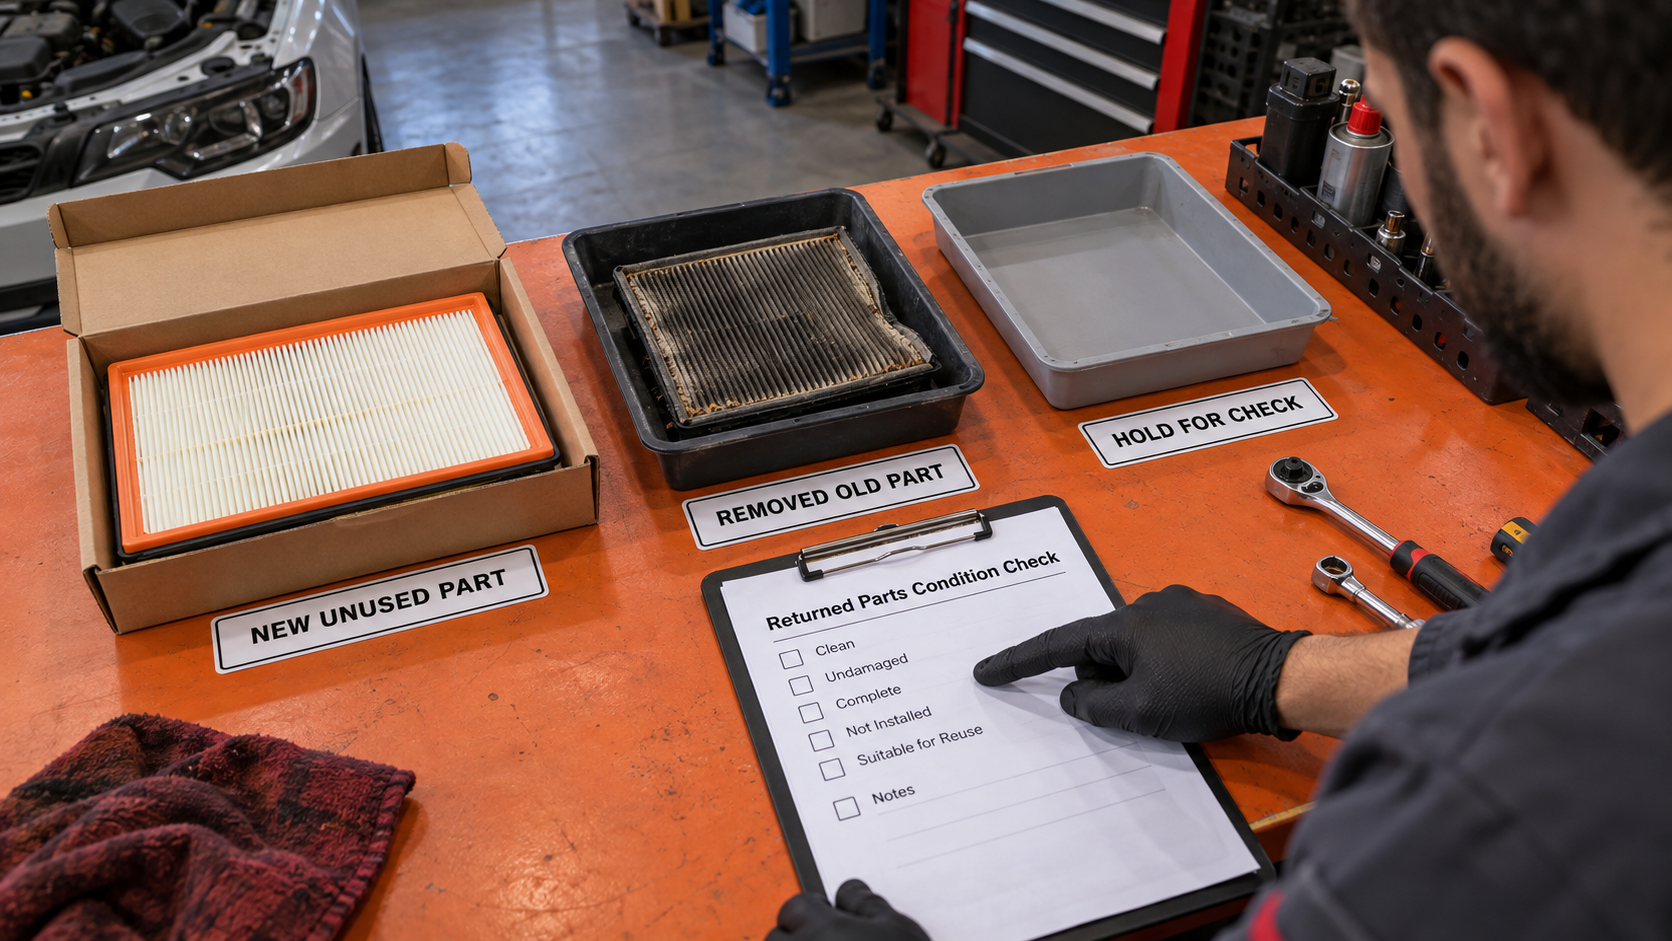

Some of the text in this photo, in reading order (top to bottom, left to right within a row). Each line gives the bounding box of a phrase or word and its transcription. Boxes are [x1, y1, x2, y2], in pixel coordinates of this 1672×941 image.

[1111, 396, 1303, 447] HOLD FOR CHECK
[716, 463, 943, 526] REMOVED OLD PART
[251, 569, 505, 644] NEW UNUSED PART
[766, 551, 1060, 631] Returned Parts Condition Check
[816, 641, 855, 656] Clean
[825, 653, 908, 682] Undamaged
[836, 686, 901, 709] Complete
[846, 706, 932, 737] Not Installed
[857, 726, 983, 766] Suitable for Reuse
[872, 786, 915, 804] Notes
